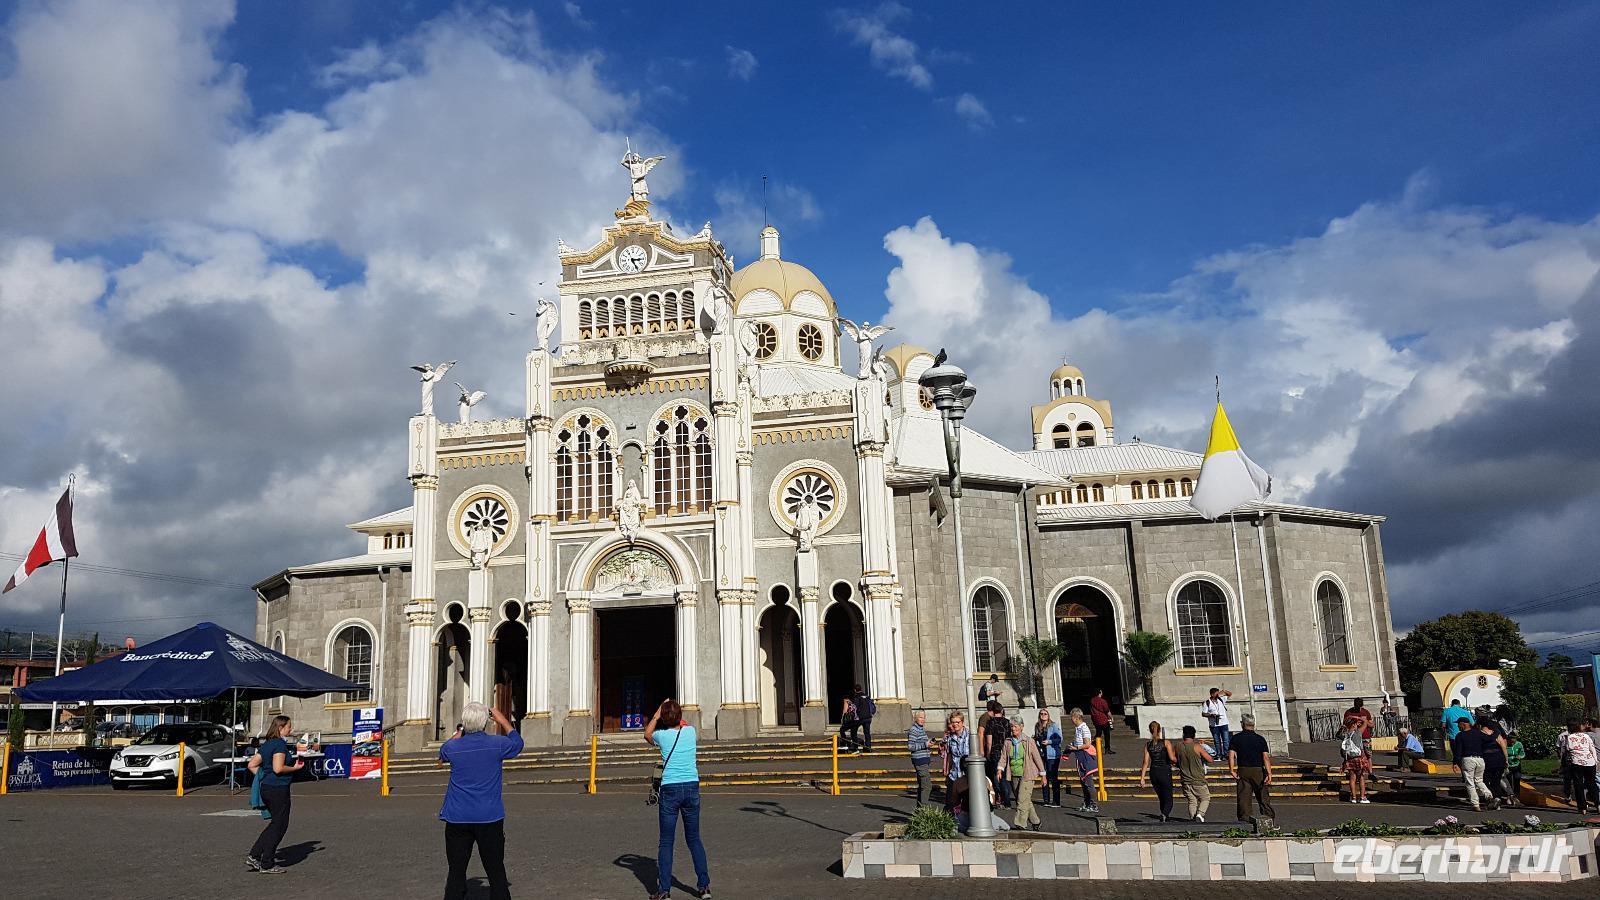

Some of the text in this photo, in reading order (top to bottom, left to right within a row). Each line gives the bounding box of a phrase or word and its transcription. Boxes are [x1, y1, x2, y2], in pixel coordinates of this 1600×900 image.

[120, 650, 199, 662] Bancrédito
[52, 760, 73, 769] Reina
[74, 759, 83, 768] de
[84, 759, 91, 767] la
